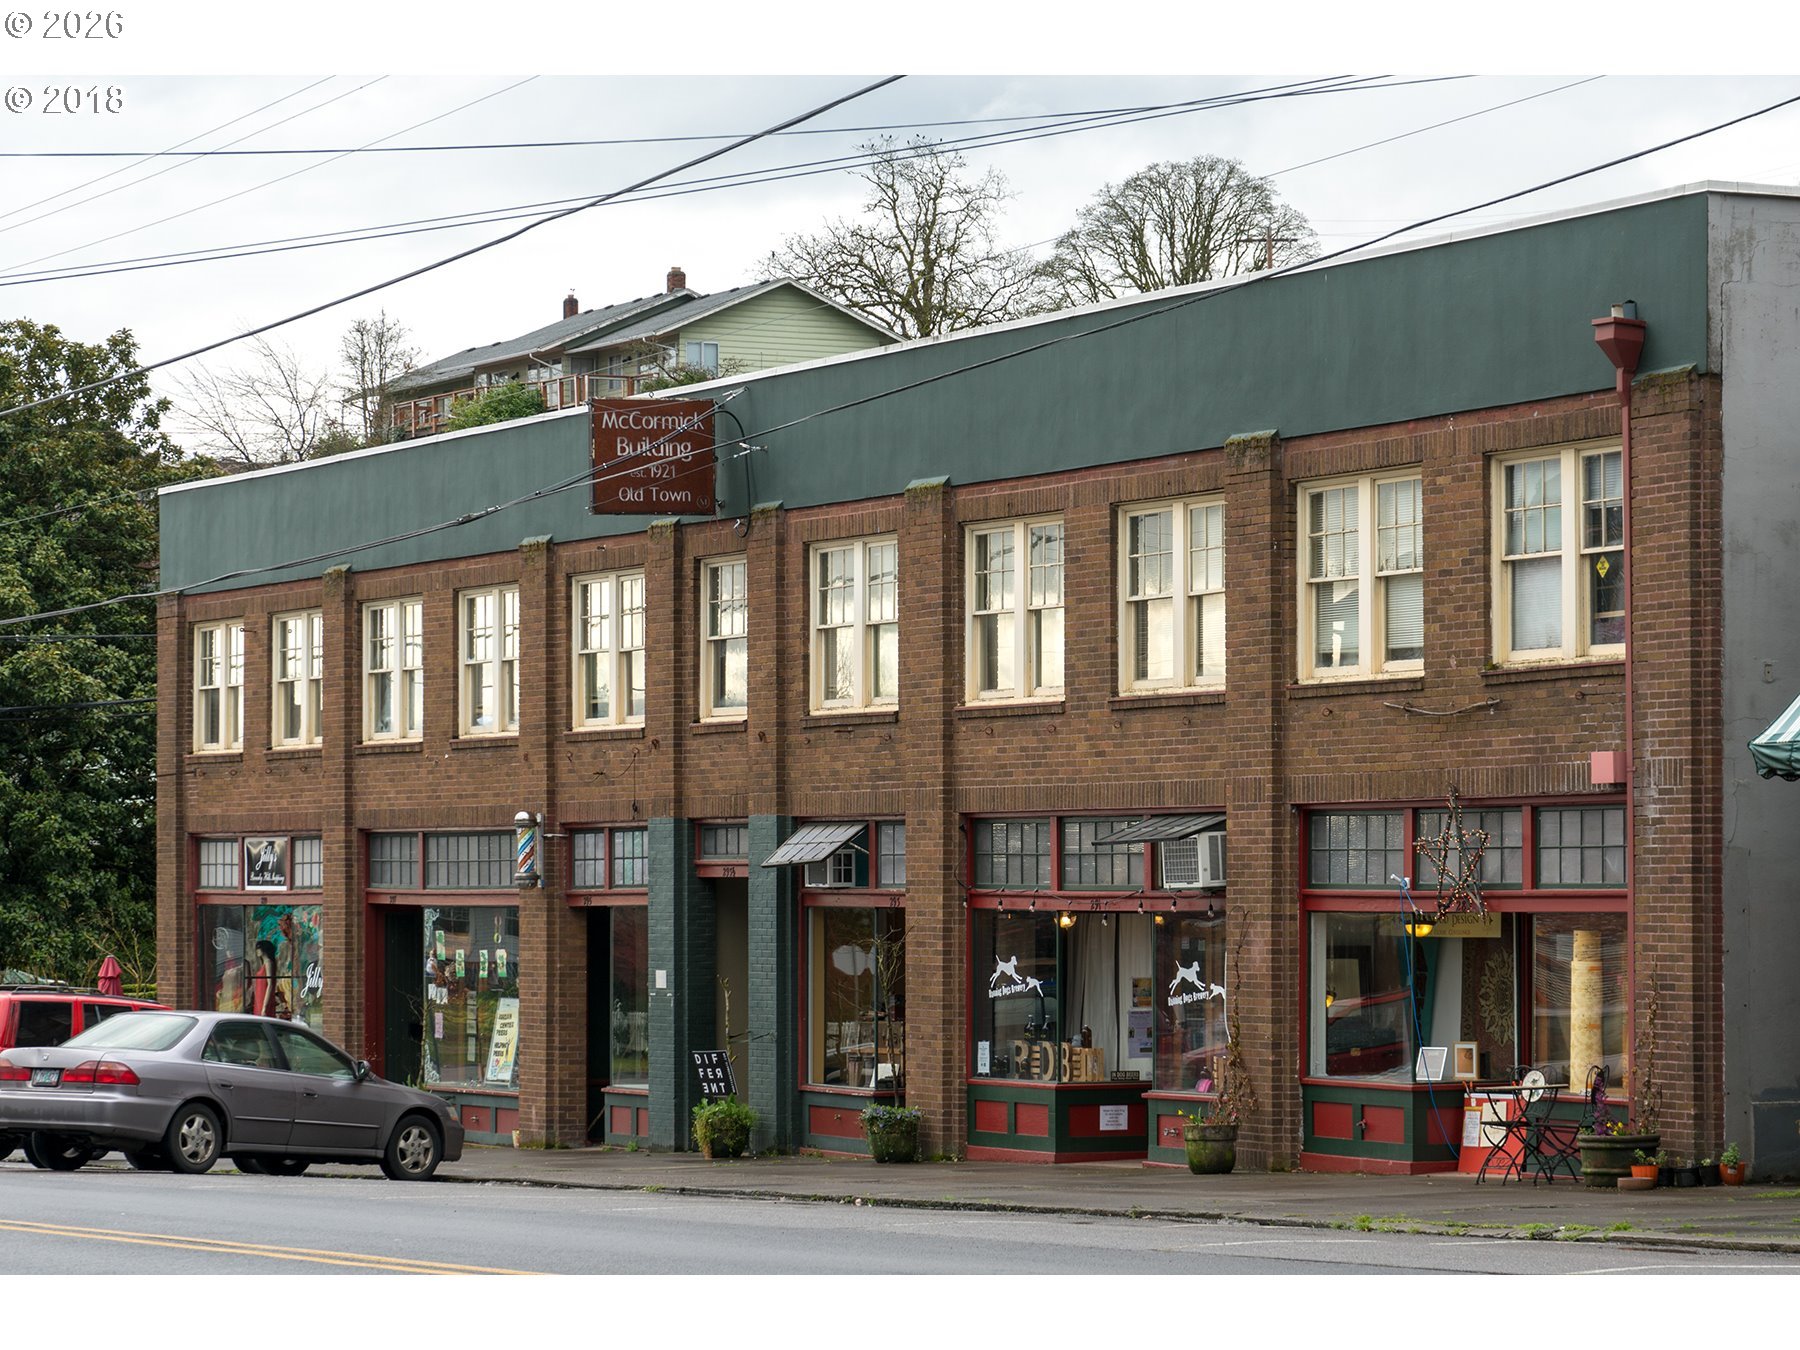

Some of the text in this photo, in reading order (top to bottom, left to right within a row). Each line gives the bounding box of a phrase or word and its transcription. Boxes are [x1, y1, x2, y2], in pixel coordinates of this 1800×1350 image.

[601, 411, 705, 430] McCormick
[616, 436, 692, 462] Building
[650, 464, 676, 478] 1921
[618, 487, 691, 502] Old Town
[255, 845, 278, 870] Jilly's
[1011, 984, 1026, 994] Brewery
[1193, 991, 1209, 1001] Brewery
[694, 1053, 718, 1065] DIF
